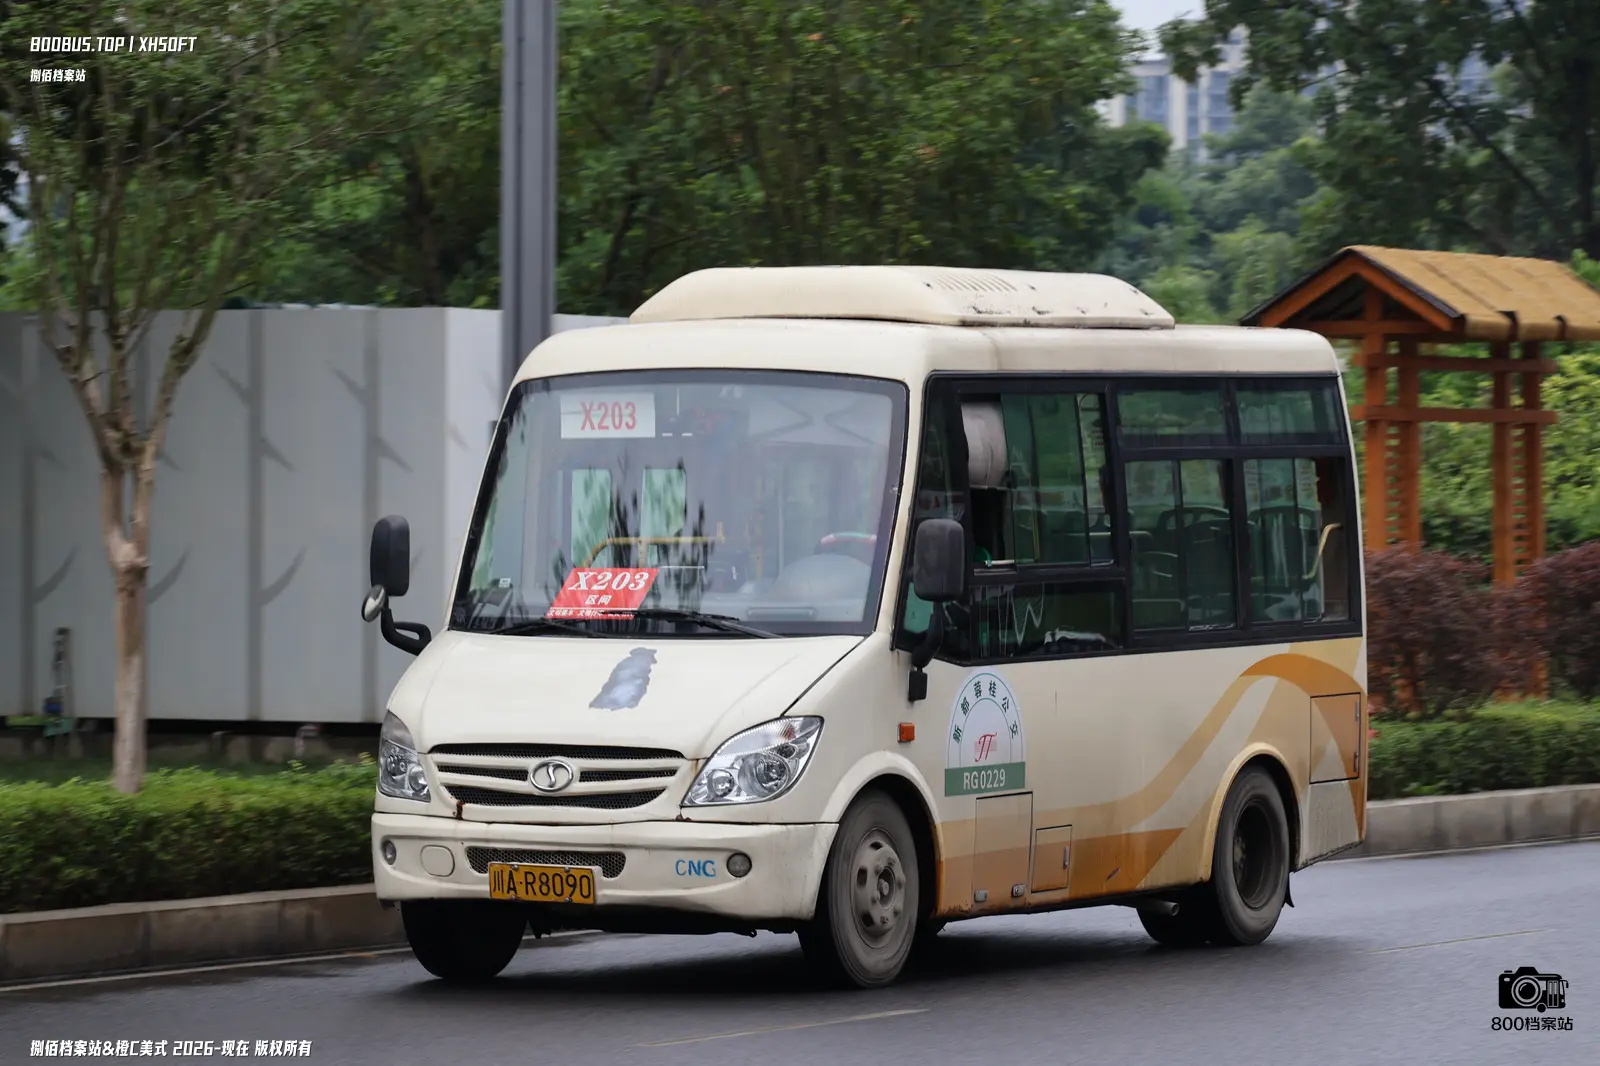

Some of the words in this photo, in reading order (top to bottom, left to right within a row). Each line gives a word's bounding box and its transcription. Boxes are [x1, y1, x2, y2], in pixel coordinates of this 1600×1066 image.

[580, 401, 637, 430] X203
[568, 571, 650, 591] X203
[585, 594, 612, 605] 区间
[963, 768, 1006, 790] RG0229
[675, 859, 717, 877] CNG
